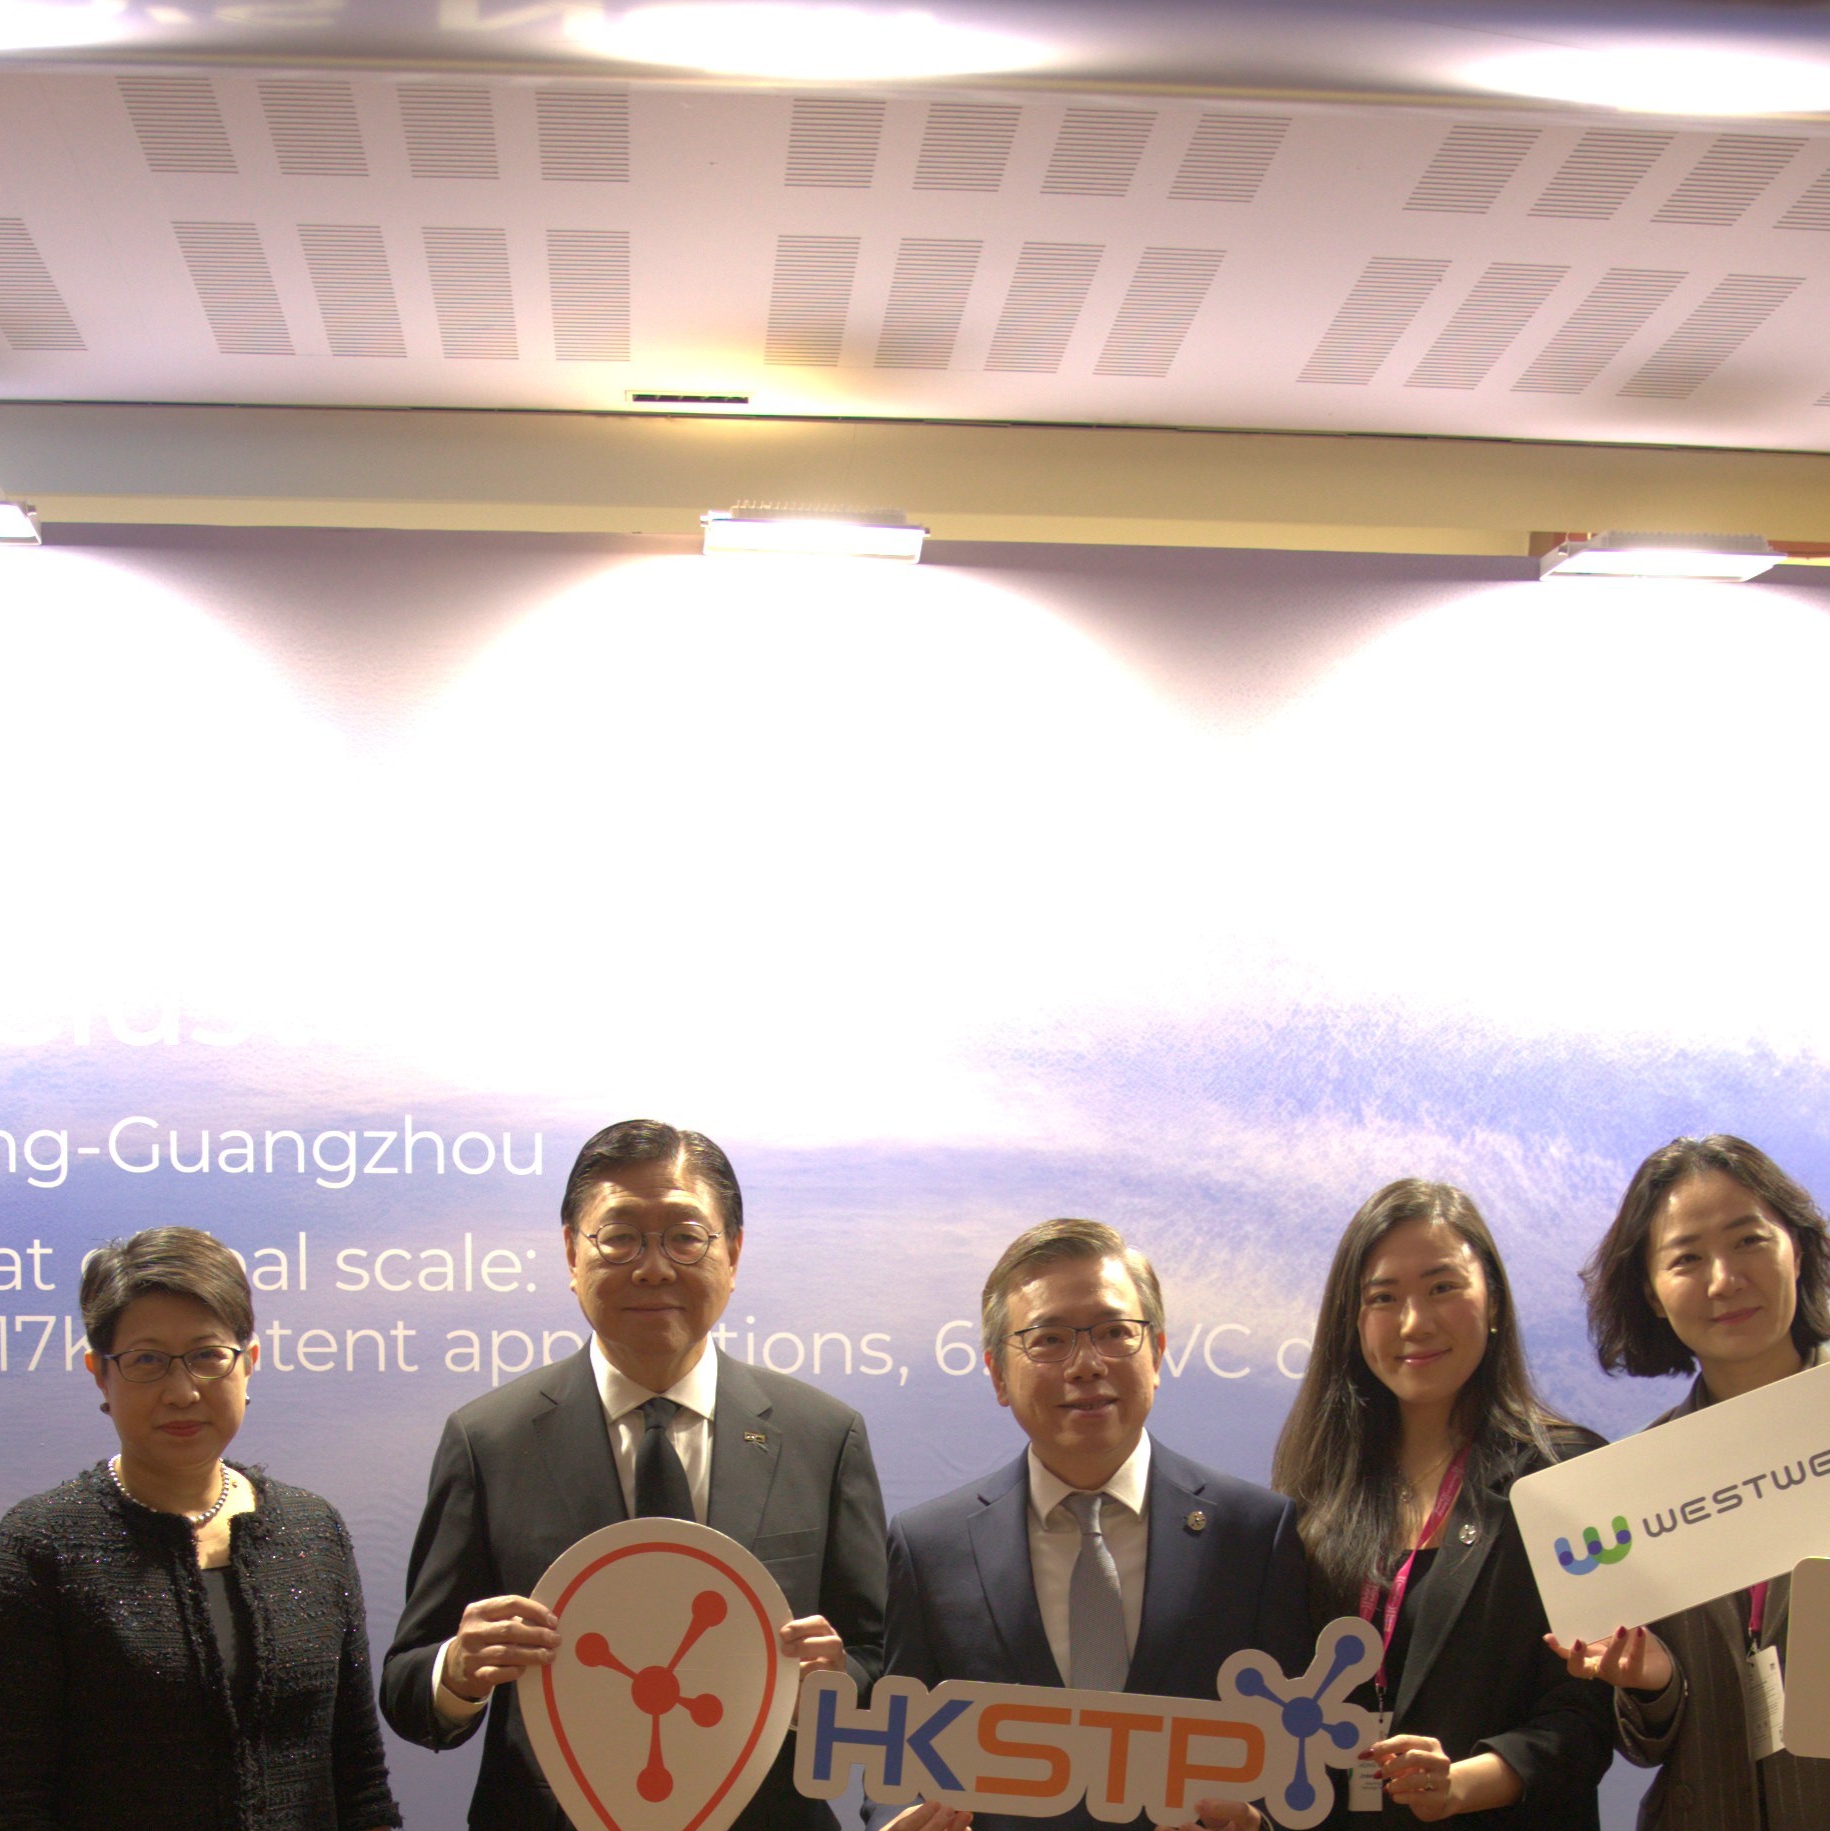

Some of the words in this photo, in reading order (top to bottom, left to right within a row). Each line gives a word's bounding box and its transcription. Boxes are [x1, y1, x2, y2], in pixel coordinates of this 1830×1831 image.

[335, 1233, 537, 1293] scale:
[249, 1319, 416, 1373] tent
[445, 1315, 909, 1387] apptions,
[812, 1688, 1266, 1809] HKSTP
